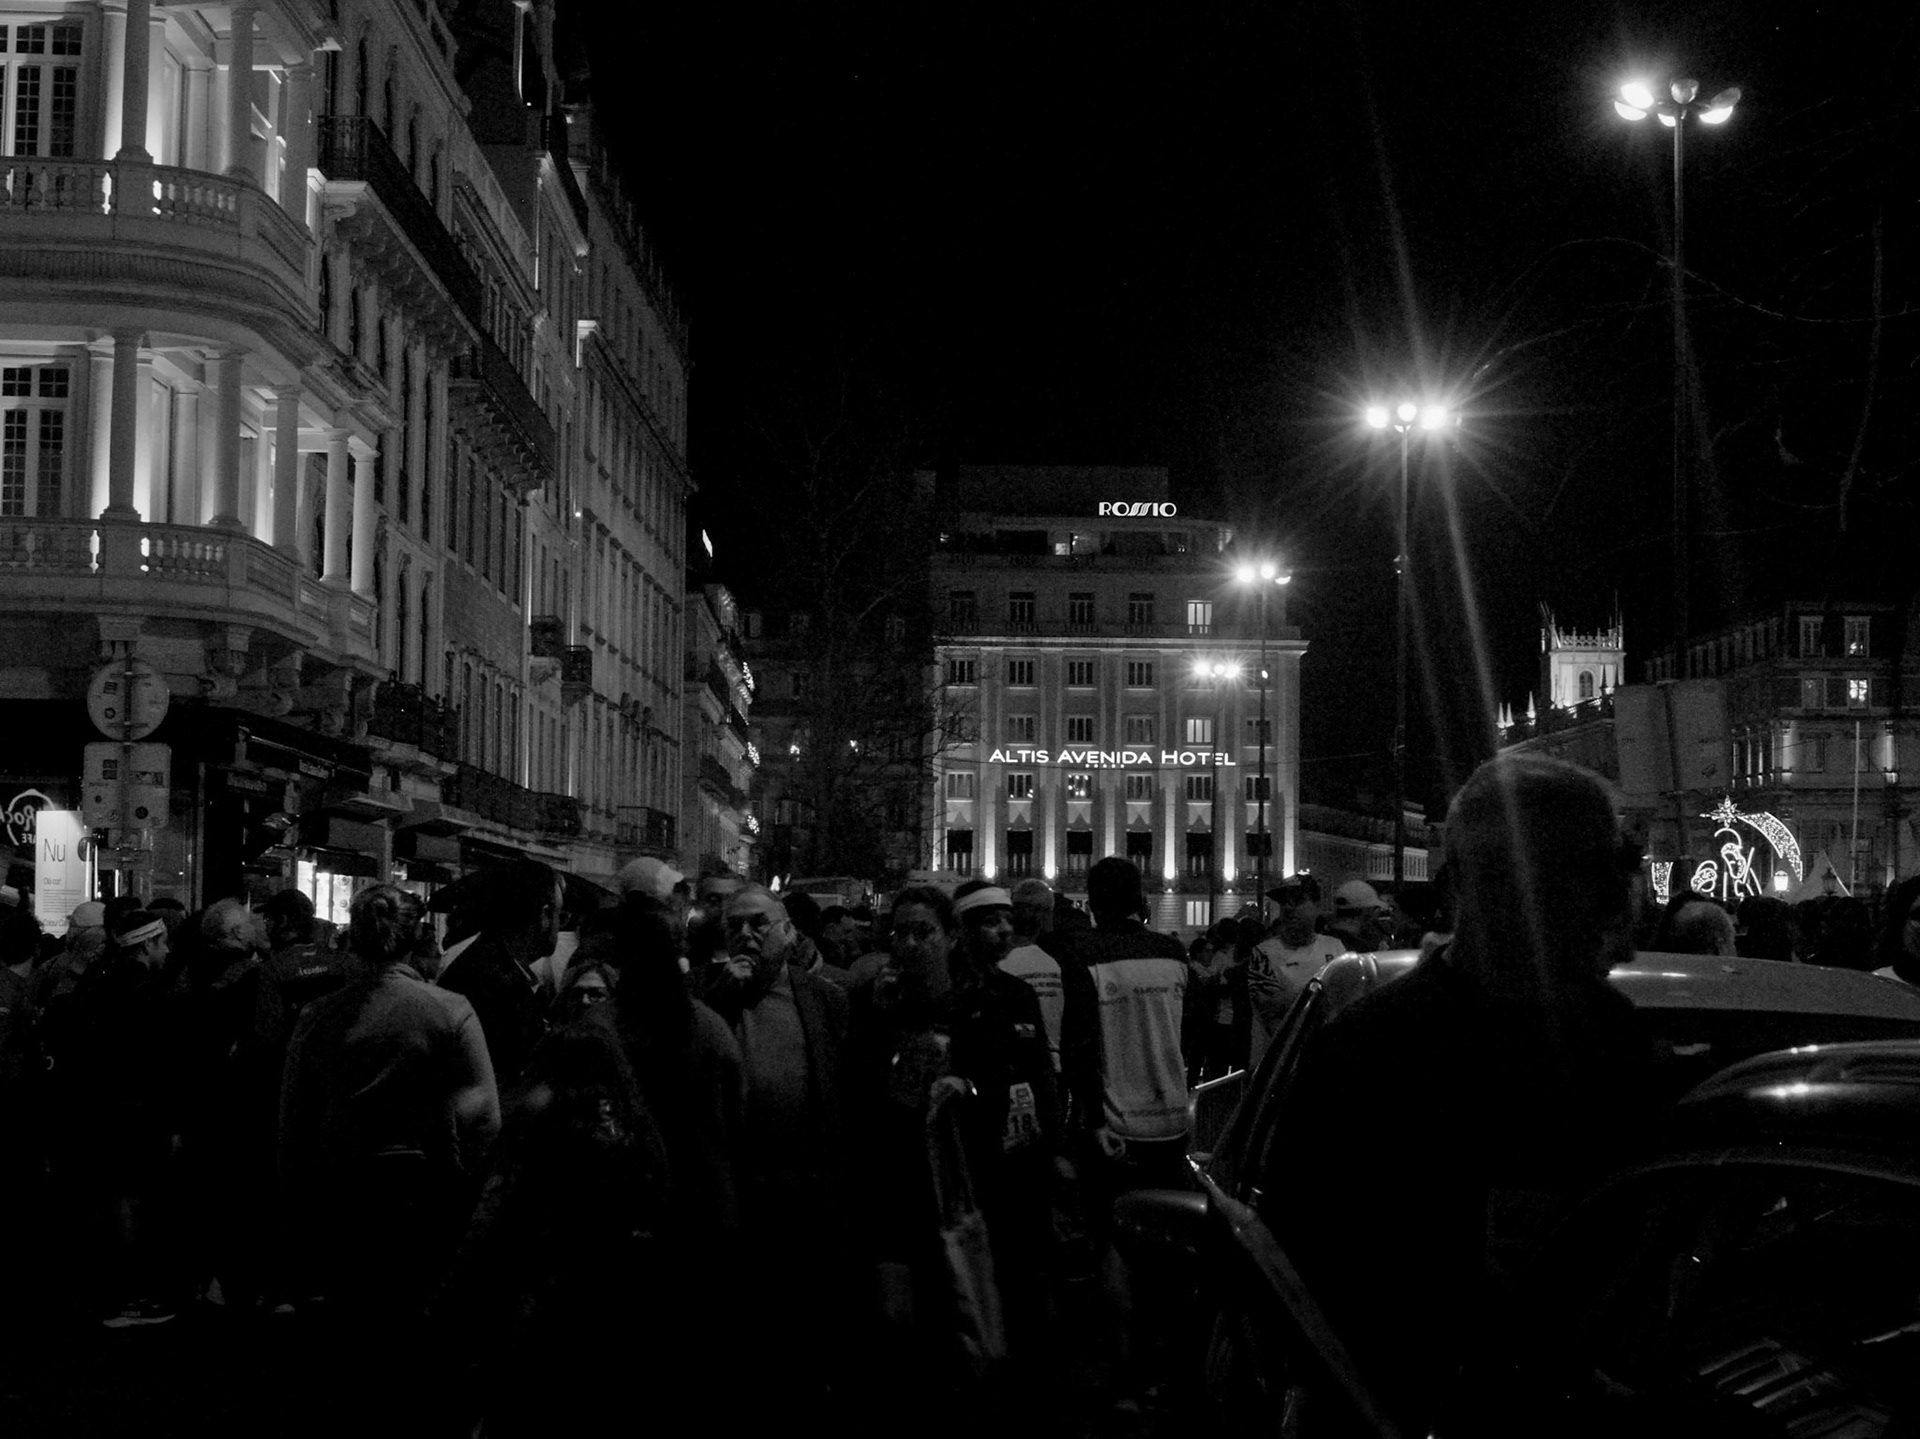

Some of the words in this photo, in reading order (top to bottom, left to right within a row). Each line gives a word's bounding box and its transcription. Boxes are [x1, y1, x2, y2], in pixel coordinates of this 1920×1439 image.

[1098, 501, 1177, 518] ROSSIO
[988, 748, 1050, 764] ALTIS
[1056, 749, 1153, 765] AVENIDA
[1161, 750, 1237, 766] HOTEL
[43, 837, 67, 863] Nu
